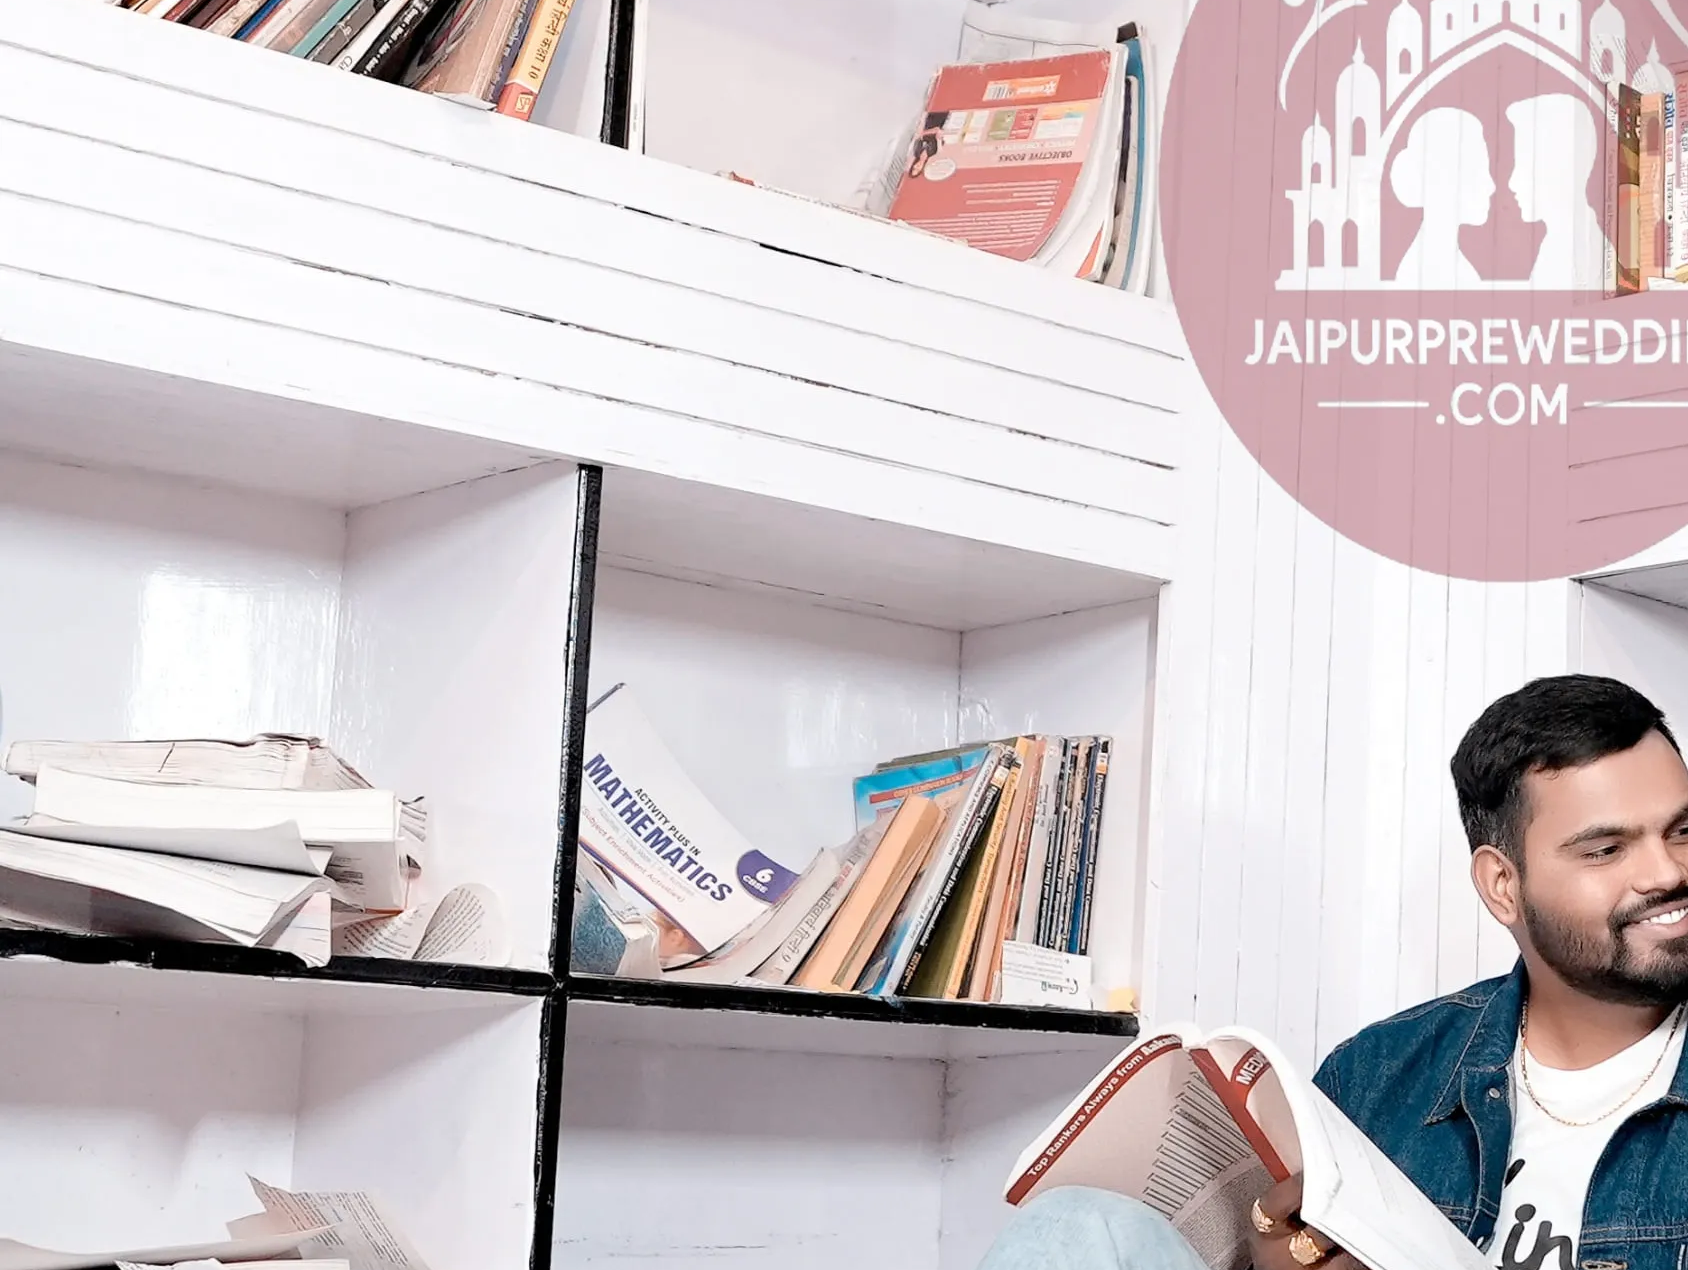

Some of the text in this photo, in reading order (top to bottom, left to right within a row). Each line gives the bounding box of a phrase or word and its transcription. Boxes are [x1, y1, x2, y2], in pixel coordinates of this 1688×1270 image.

[543, 8, 566, 36] हिन्दी
[534, 37, 552, 62] कक्षा
[527, 64, 542, 80] 10
[998, 150, 1071, 162] OBJECTIVE BOOKS
[583, 754, 733, 901] MATHEMATICS
[635, 787, 702, 857] ACTIVITY PLUS IN
[742, 875, 769, 894] CBSE
[756, 868, 775, 885] 6
[778, 951, 791, 964] 9
[1027, 1052, 1145, 1178] Top Rankers Always from
